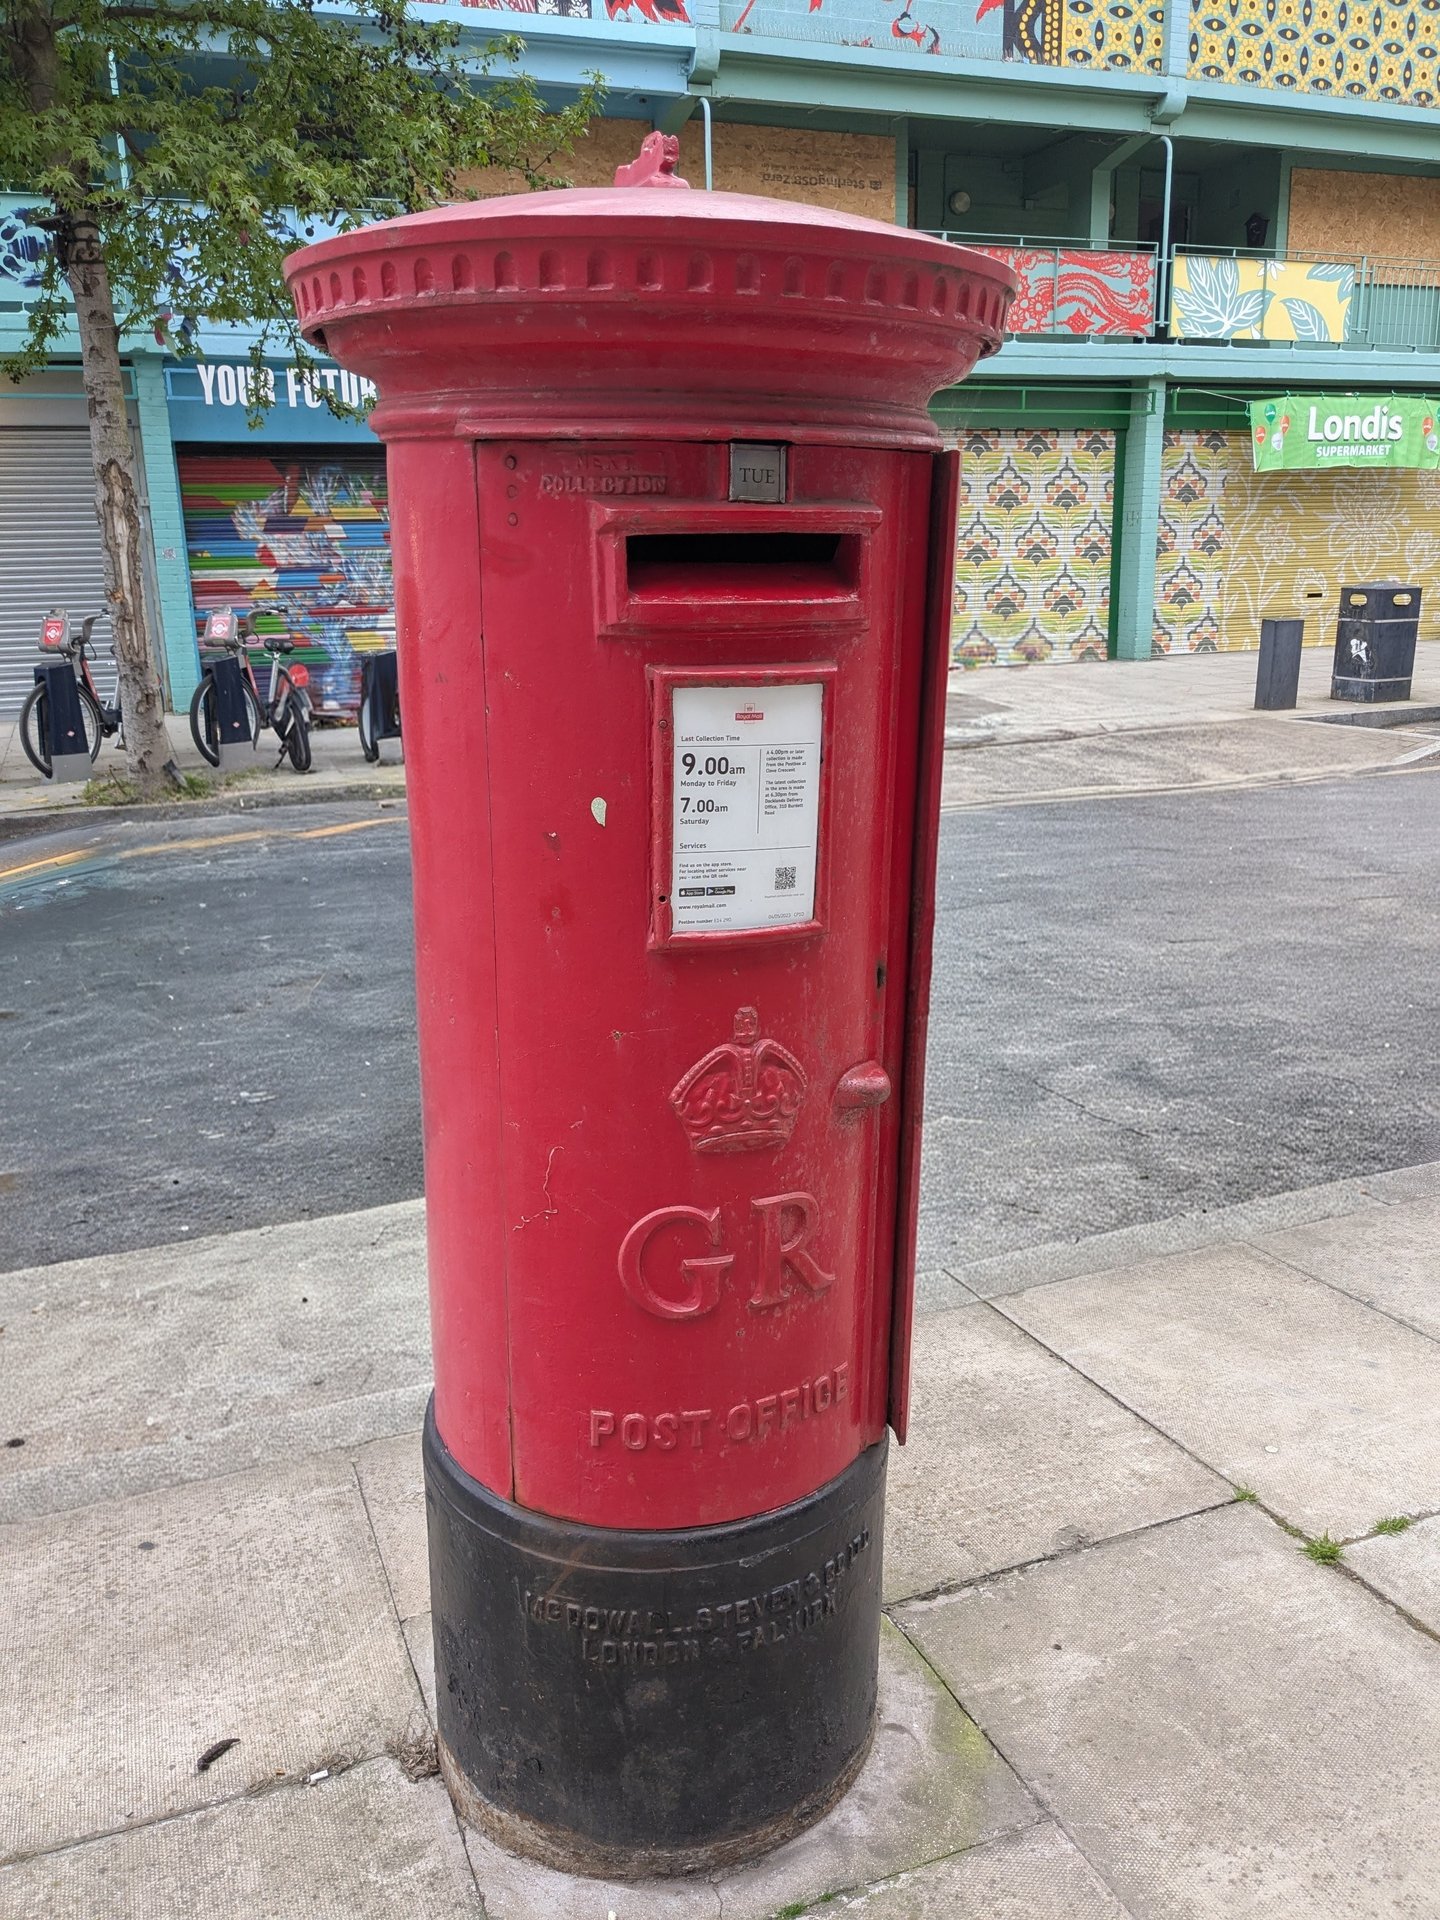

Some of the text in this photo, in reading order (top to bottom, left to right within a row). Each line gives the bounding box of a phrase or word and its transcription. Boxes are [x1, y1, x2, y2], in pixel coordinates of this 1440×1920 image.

[763, 173, 790, 183] Zero
[197, 364, 275, 407] YOUR
[1308, 405, 1403, 442] Londis
[1316, 444, 1391, 457] SUPERMARKET
[541, 475, 667, 495] COLLECTION
[739, 467, 776, 485] TUE
[682, 753, 745, 775] 9.00am
[680, 797, 728, 813] 7.00am
[590, 1361, 849, 1451] POST OFFICE
